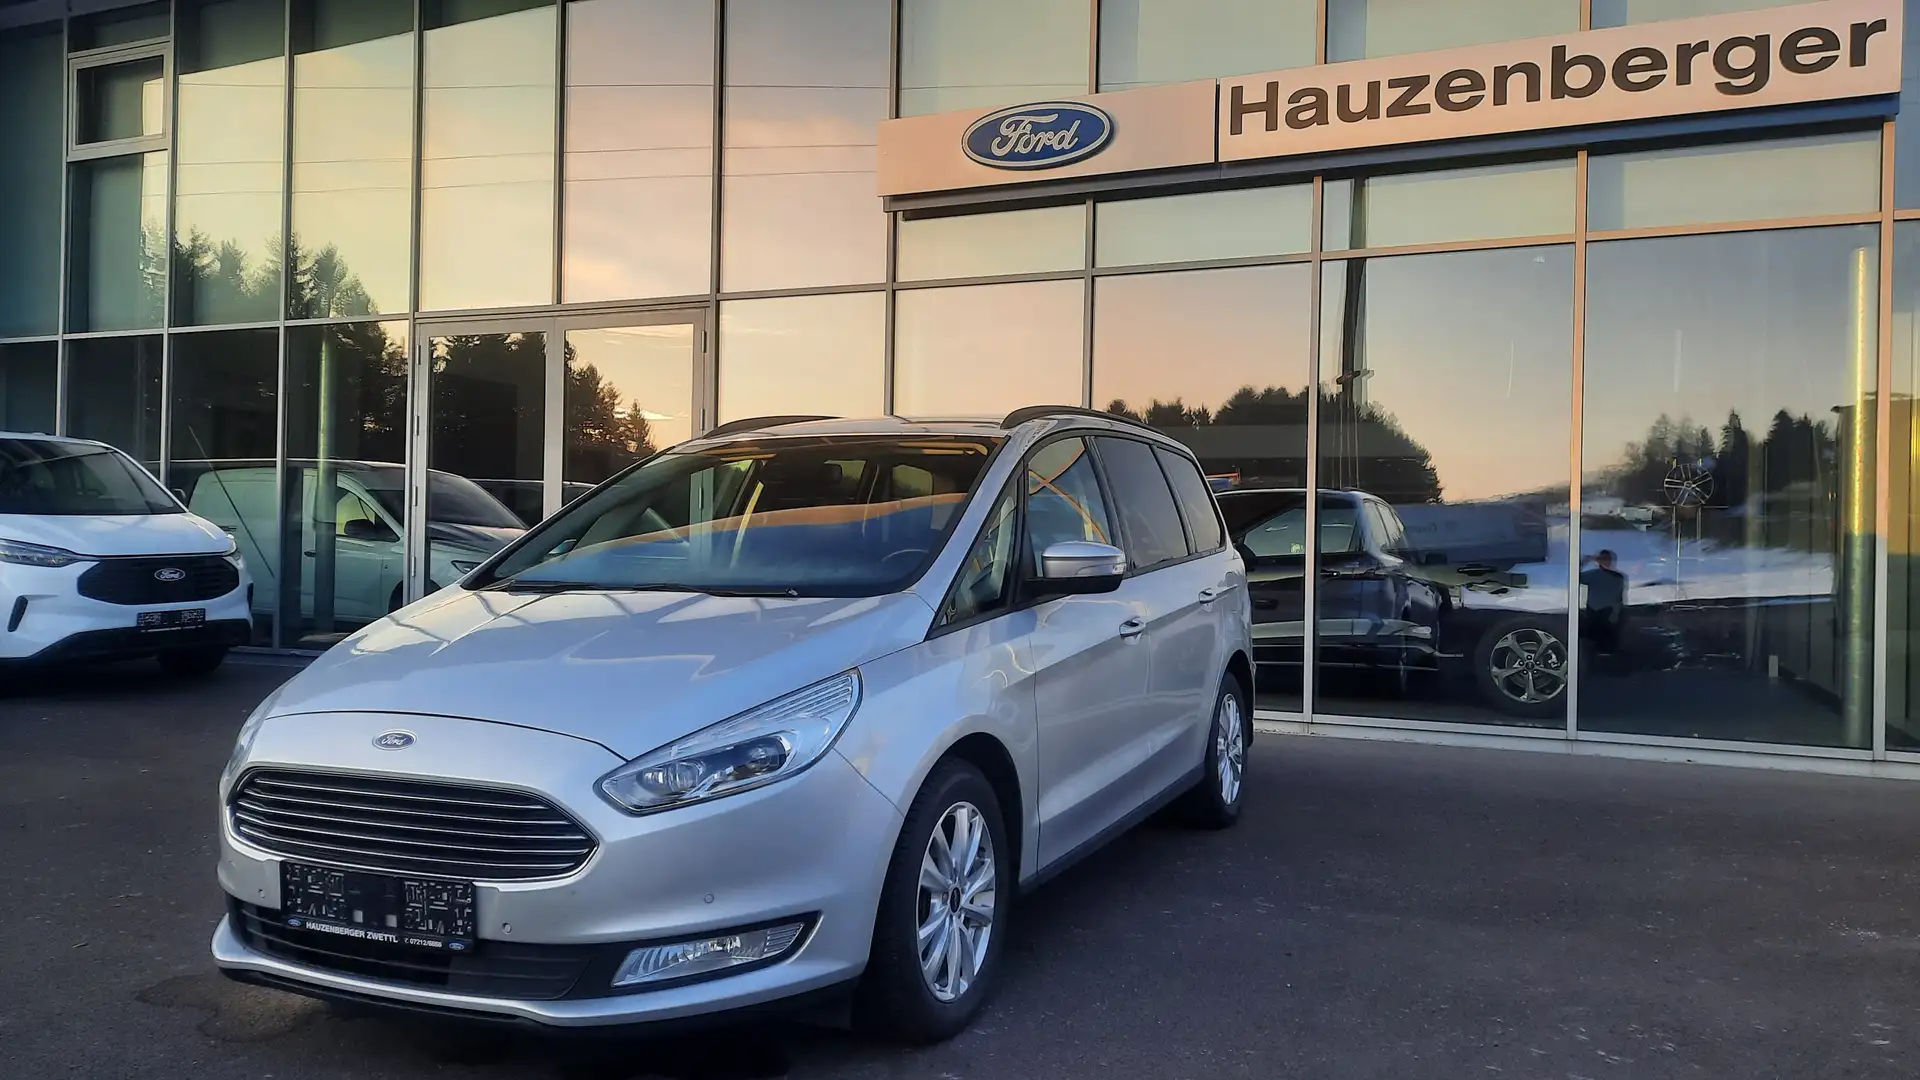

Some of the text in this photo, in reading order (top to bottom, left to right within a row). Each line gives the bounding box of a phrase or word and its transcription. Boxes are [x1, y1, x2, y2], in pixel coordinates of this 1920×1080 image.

[1229, 18, 1887, 136] Hauzenberger
[990, 113, 1082, 156] Ford
[305, 921, 365, 939] HAUZENBERGER
[366, 931, 399, 943] ZWETTL
